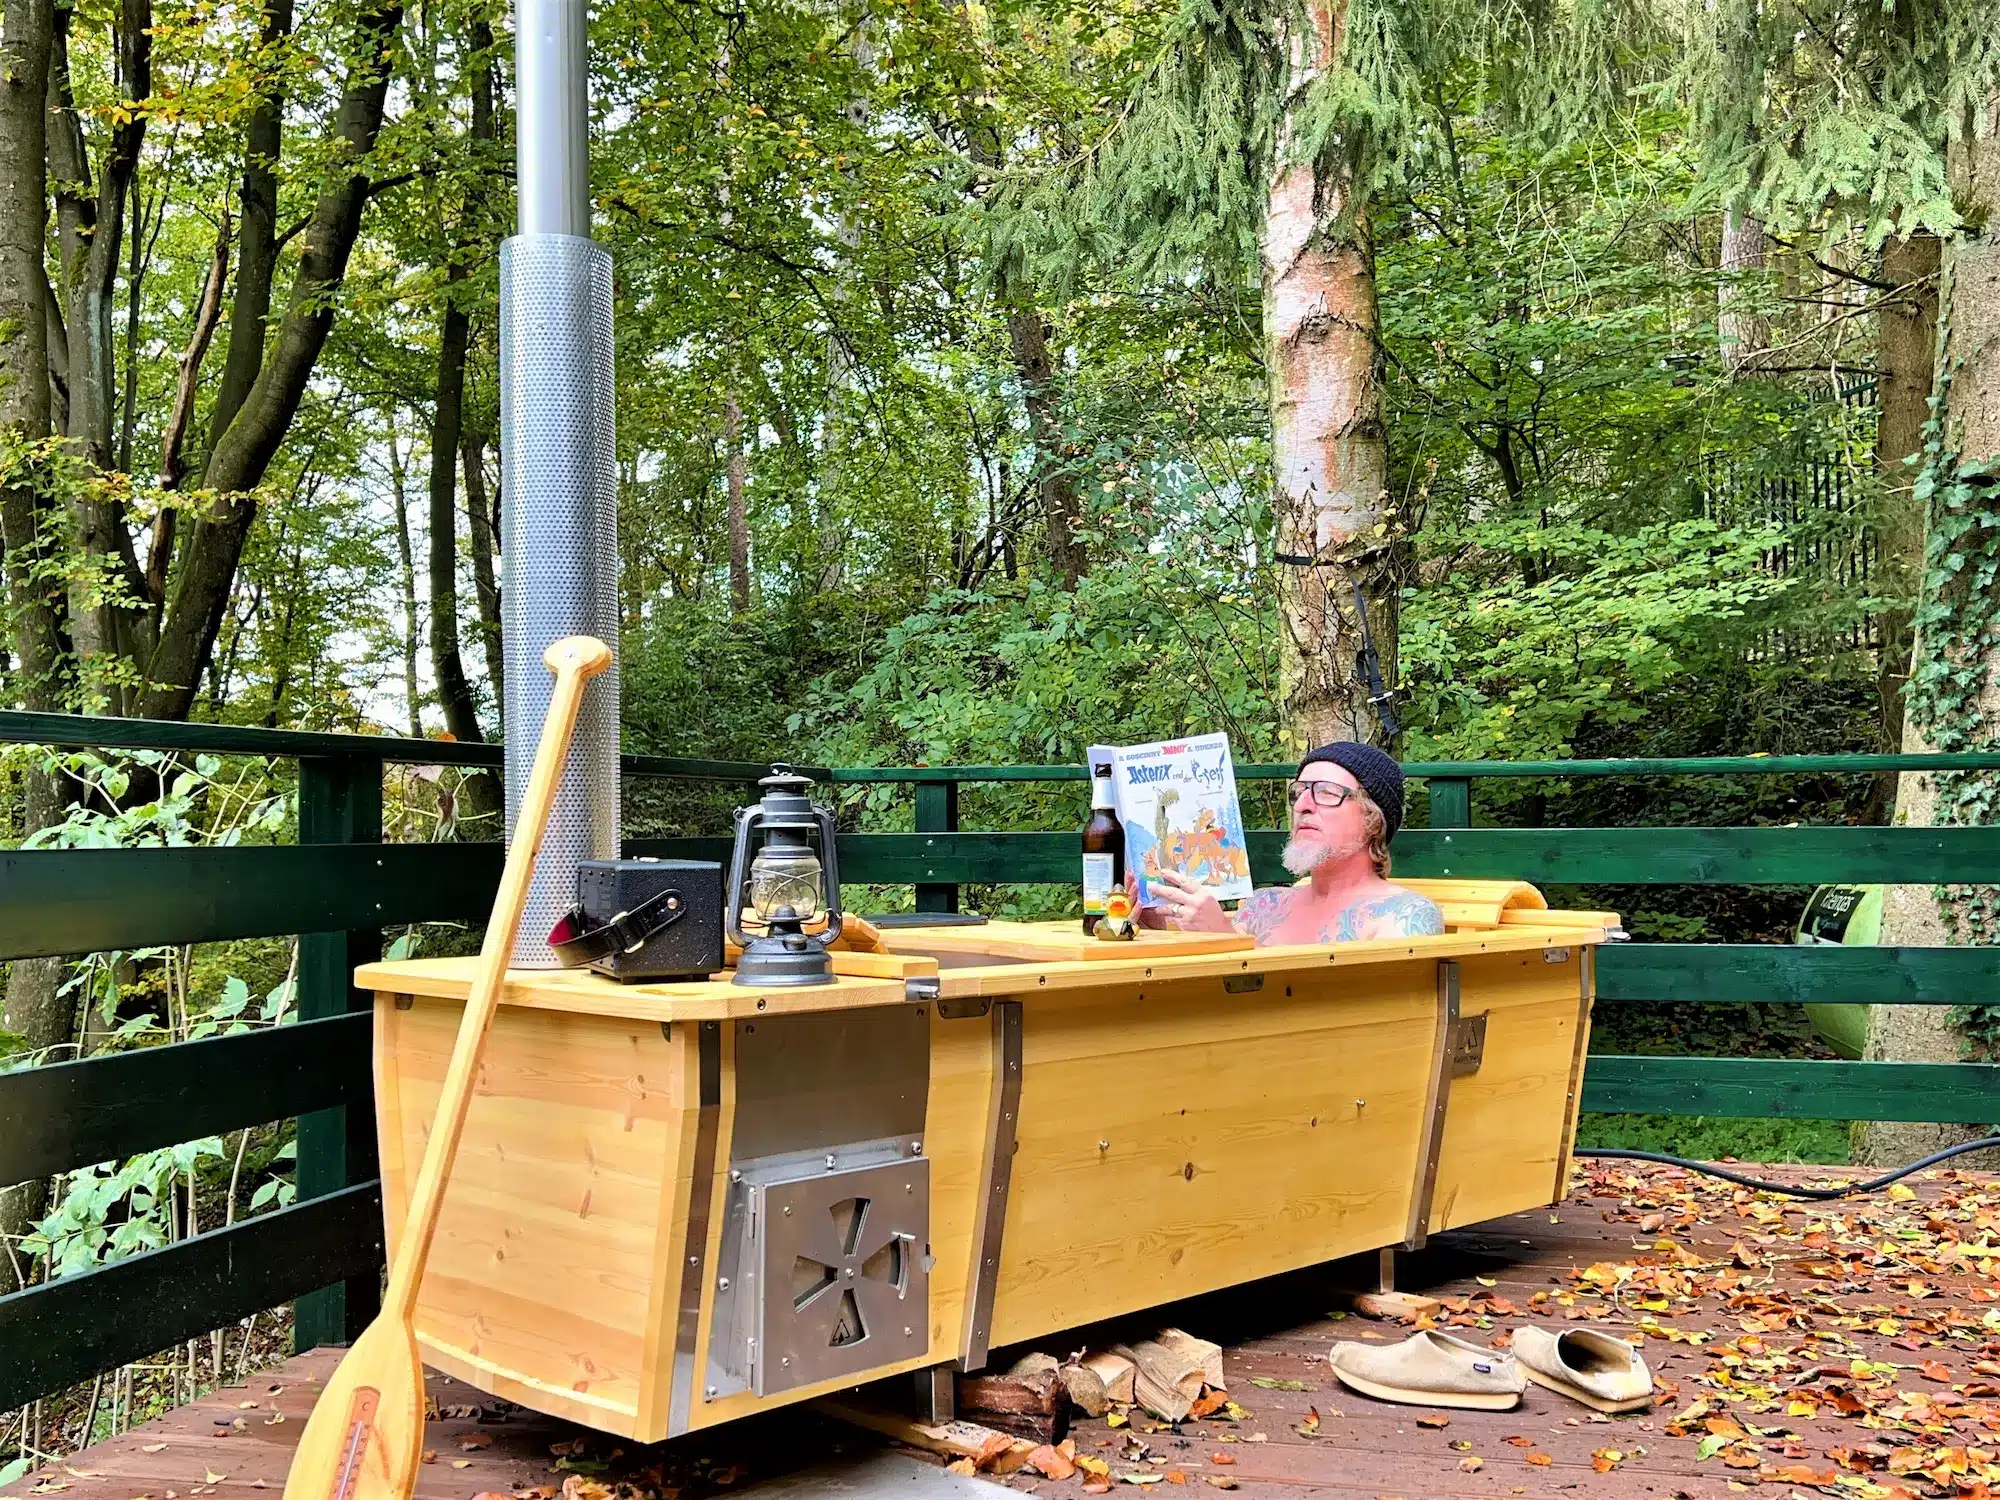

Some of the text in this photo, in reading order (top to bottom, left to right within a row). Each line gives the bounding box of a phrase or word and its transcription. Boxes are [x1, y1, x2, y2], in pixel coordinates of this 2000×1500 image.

[1195, 743, 1223, 751] UDERZO
[1127, 763, 1173, 785] Asterix
[1172, 770, 1184, 780] und
[1183, 774, 1193, 784] der
